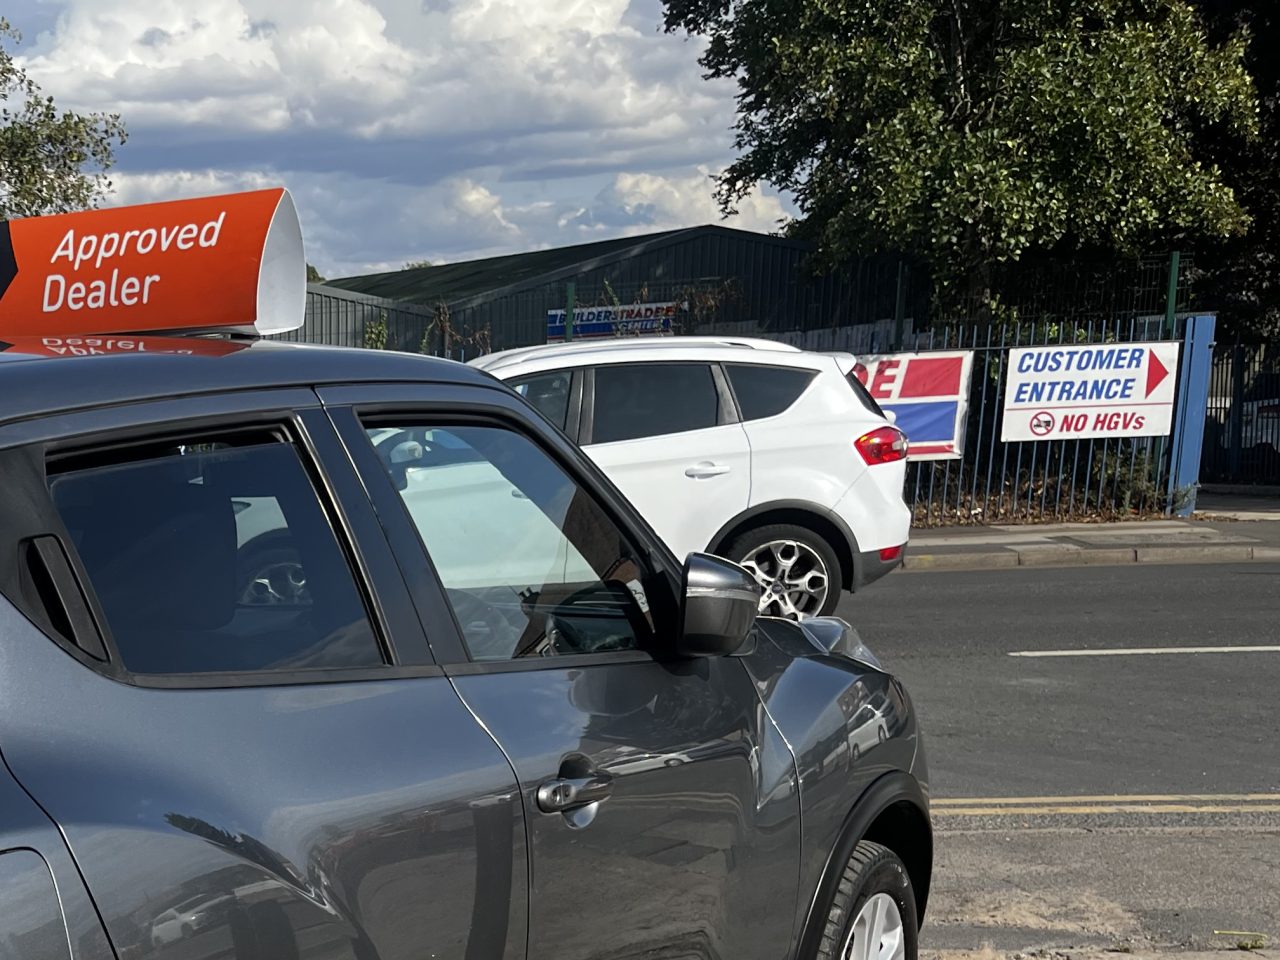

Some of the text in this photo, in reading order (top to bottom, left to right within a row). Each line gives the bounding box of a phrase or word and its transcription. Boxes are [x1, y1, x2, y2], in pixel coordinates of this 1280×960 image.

[50, 211, 226, 271] Approved
[42, 268, 160, 313] Dealer
[1017, 347, 1145, 374] CUSTOMER
[1014, 378, 1136, 404] ENTRANCE
[1059, 412, 1146, 432] NO HGVs
